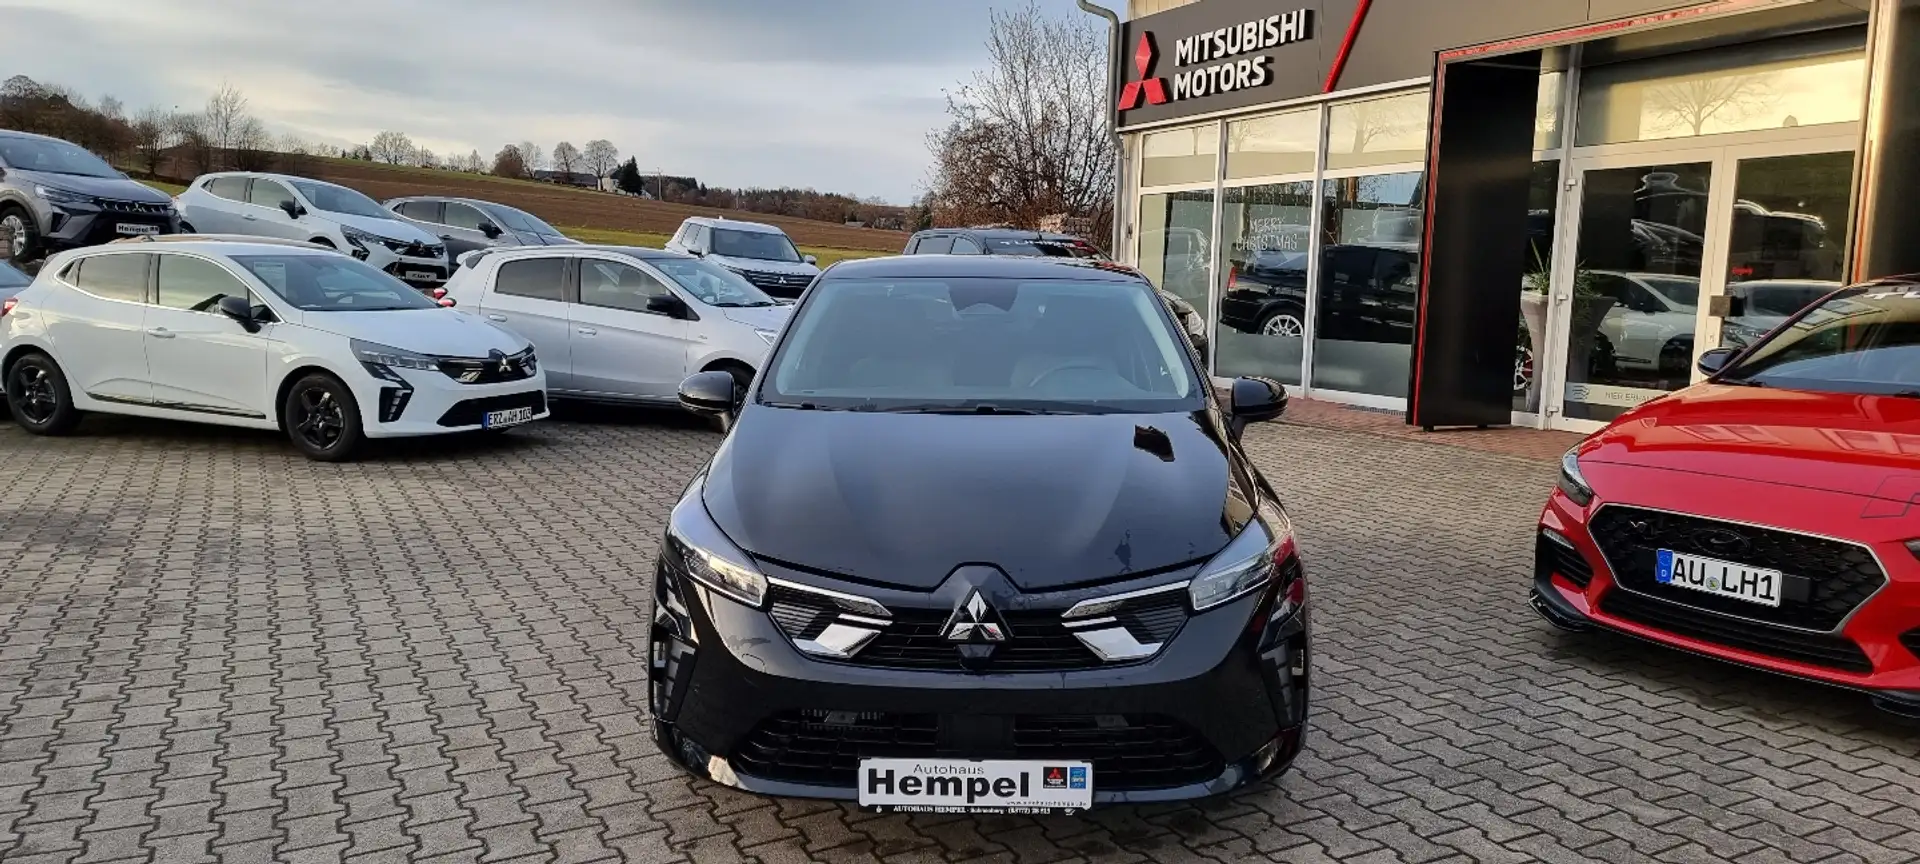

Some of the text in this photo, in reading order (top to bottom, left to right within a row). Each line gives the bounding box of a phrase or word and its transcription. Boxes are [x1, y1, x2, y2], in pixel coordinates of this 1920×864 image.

[1174, 9, 1306, 67] MITSUBISHI
[1173, 55, 1266, 100] MOTORS
[1250, 217, 1283, 232] MERRY
[1235, 233, 1297, 251] CHRISTMAS
[488, 411, 503, 426] ERZ
[1661, 569, 1667, 577] D
[1672, 557, 1706, 586] AU
[913, 763, 985, 775] Autohaus
[868, 768, 1029, 803] Hempel
[893, 805, 934, 813] AUTOHAUS
